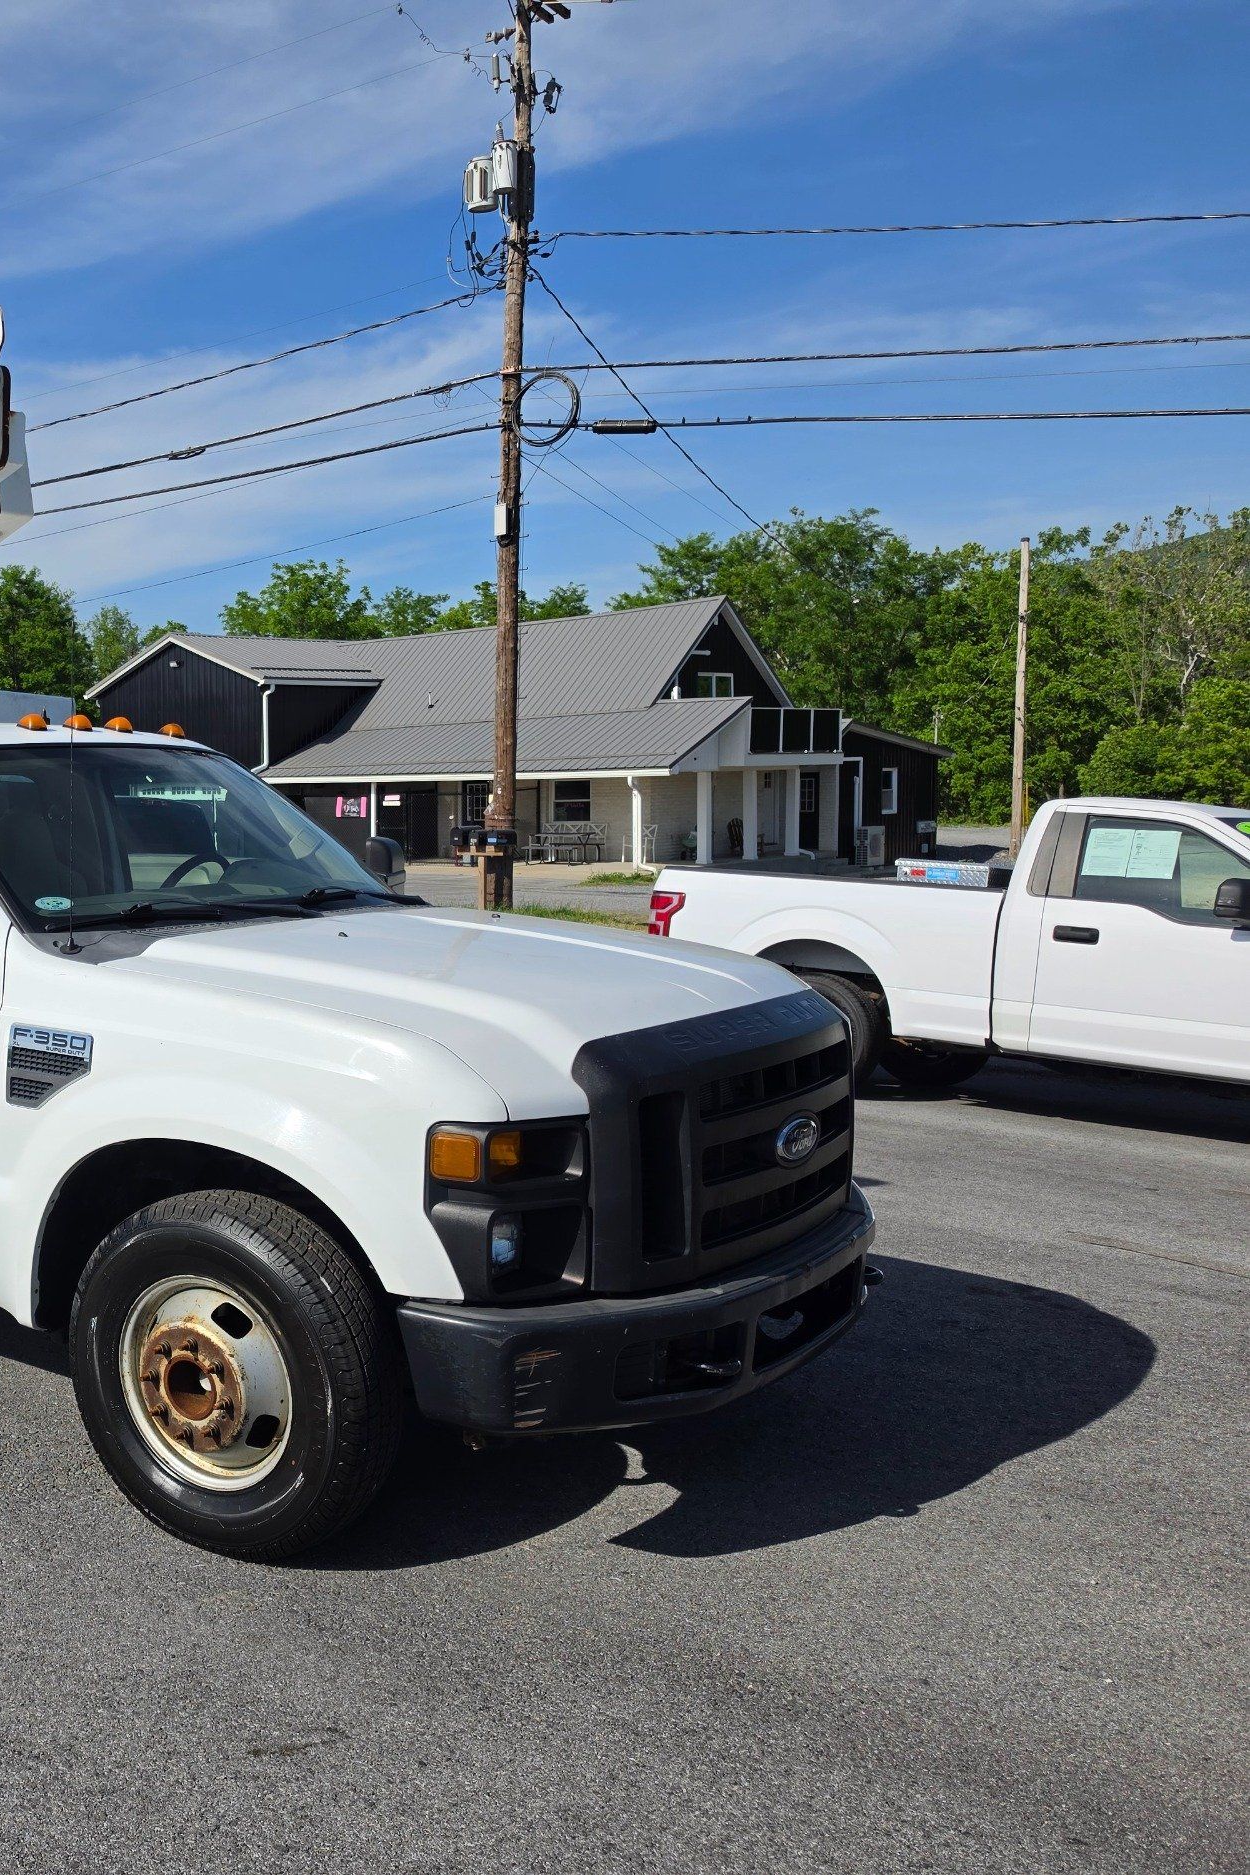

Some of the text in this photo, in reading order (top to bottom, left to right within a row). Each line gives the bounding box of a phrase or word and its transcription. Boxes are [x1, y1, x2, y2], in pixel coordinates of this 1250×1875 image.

[664, 997, 829, 1051] SUPER DUTY
[45, 1046, 67, 1054] SUPER
[791, 1127, 814, 1153] Ford
